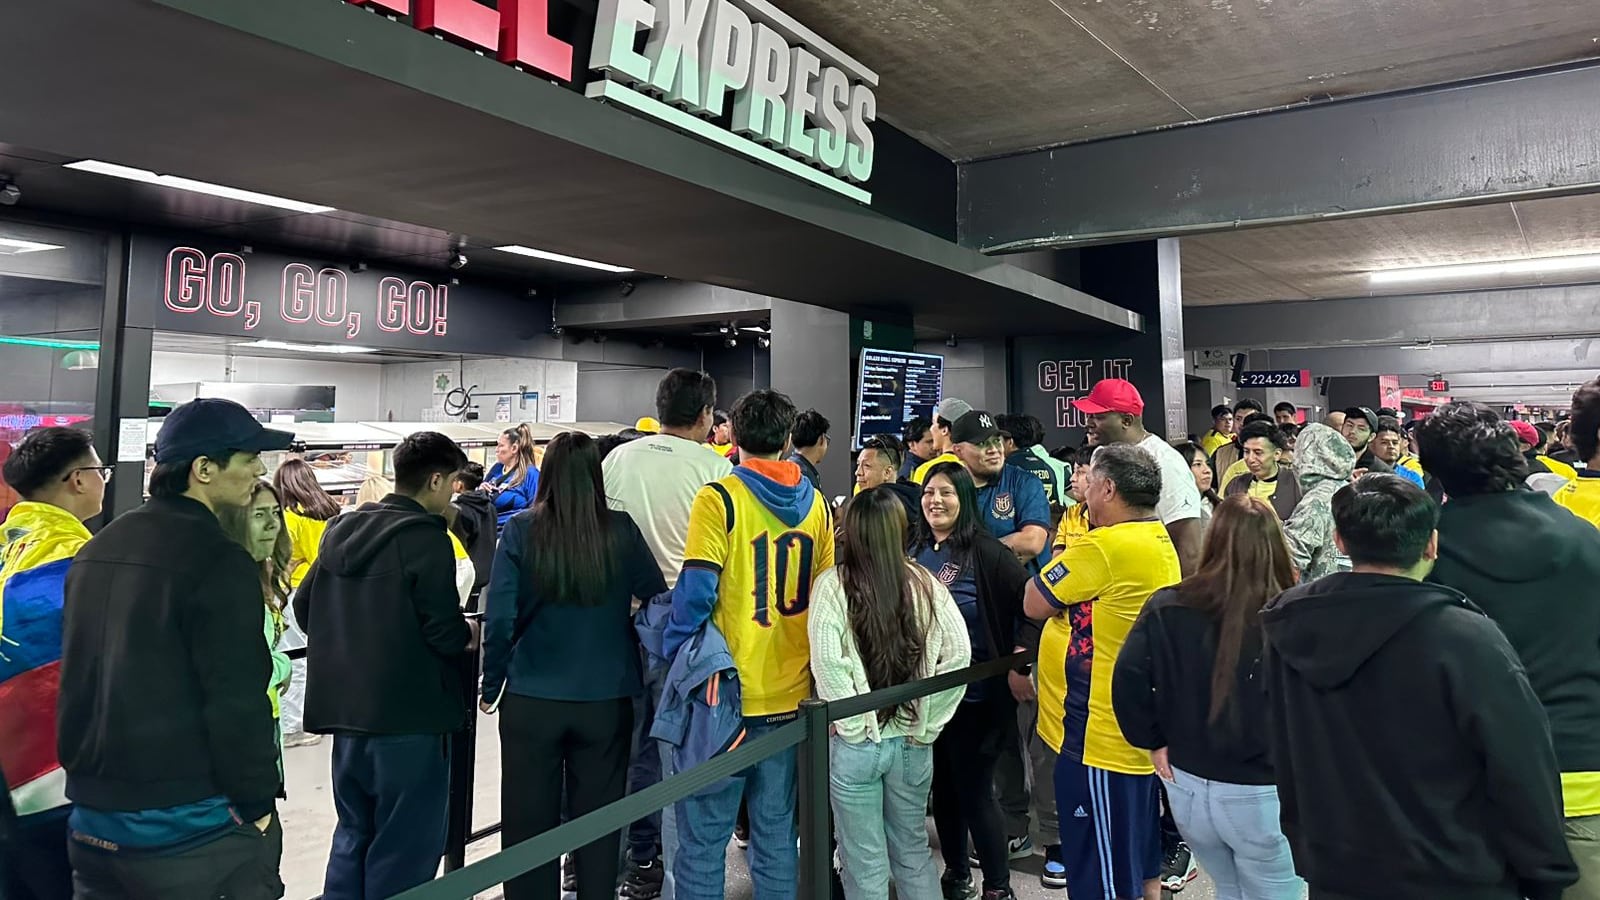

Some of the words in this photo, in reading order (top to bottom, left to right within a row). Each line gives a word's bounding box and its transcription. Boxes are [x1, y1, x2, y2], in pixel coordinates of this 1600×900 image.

[589, 0, 876, 182] EXPRESS
[164, 246, 261, 330] GO,
[280, 262, 361, 339] GO,
[376, 276, 448, 336] GO!
[1038, 360, 1093, 392] GET
[1103, 358, 1133, 381] IT
[1200, 359, 1227, 367] WOMEN
[1251, 374, 1297, 385] 224-226
[751, 530, 815, 628] 10
